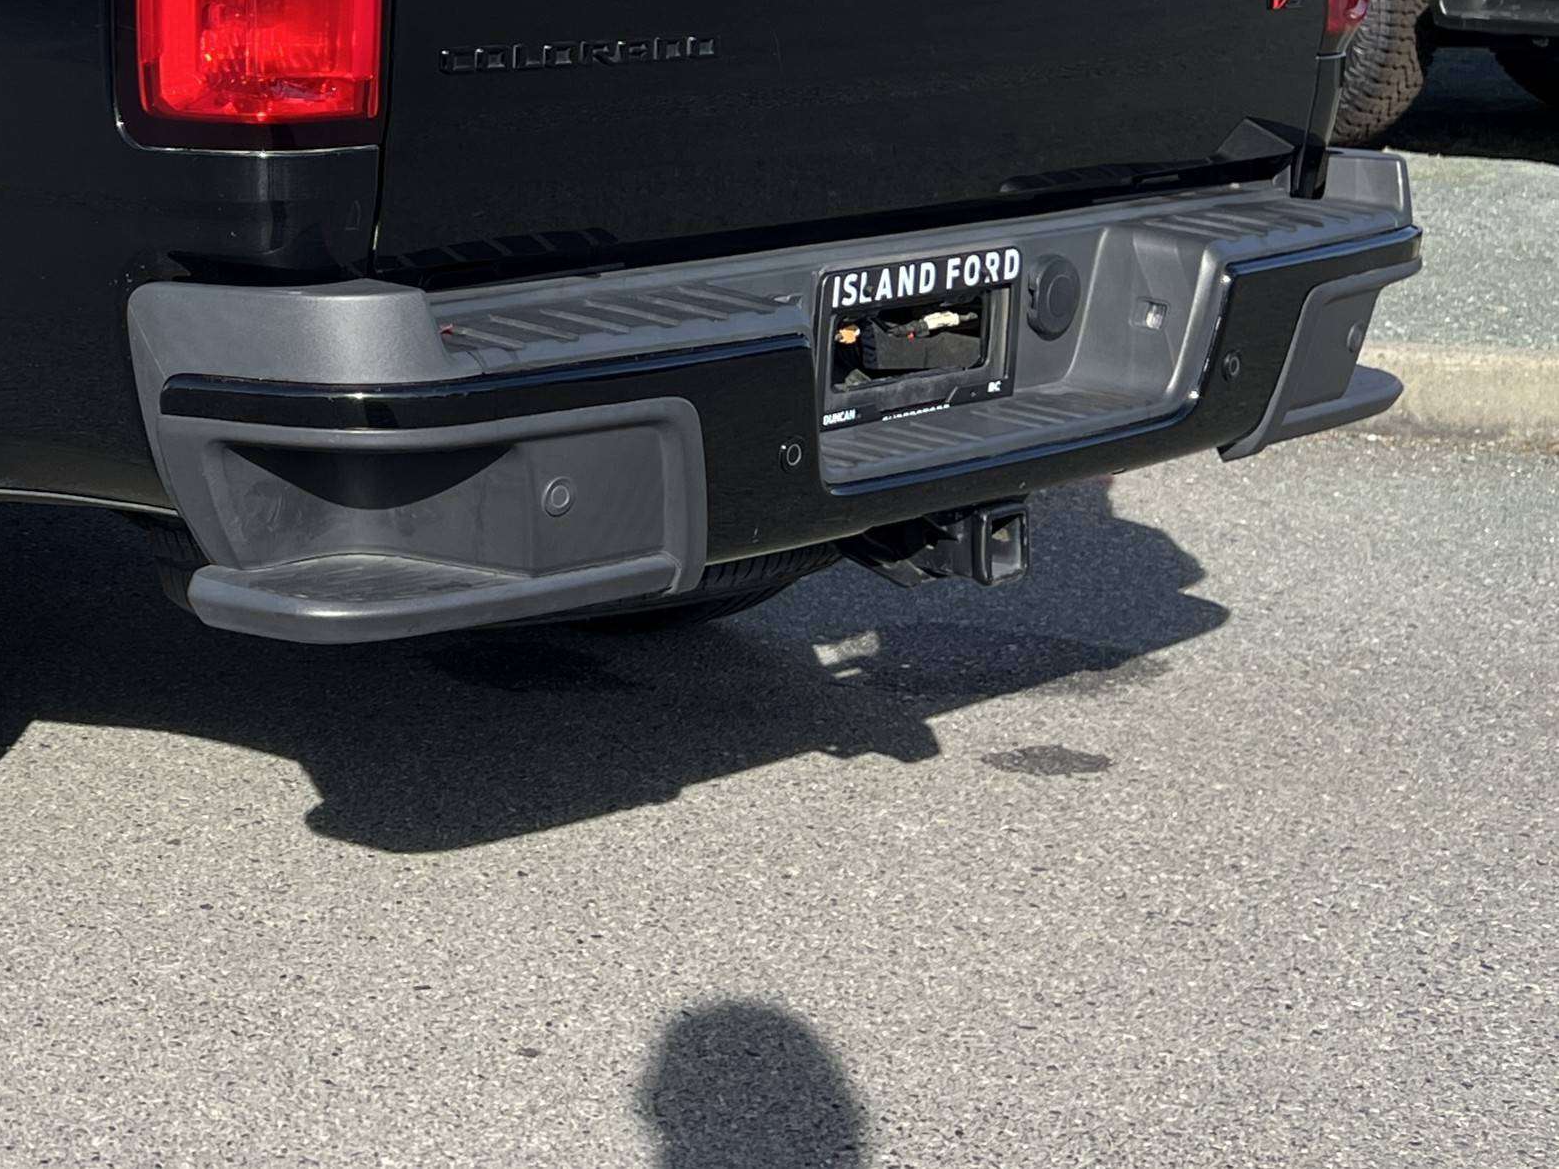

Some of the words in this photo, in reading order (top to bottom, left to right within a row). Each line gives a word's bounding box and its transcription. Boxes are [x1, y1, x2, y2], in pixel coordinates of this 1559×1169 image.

[438, 33, 720, 75] COLORADO
[831, 261, 936, 309] ISLAND
[945, 248, 1020, 290] FORD
[822, 408, 856, 426] DUNCAN
